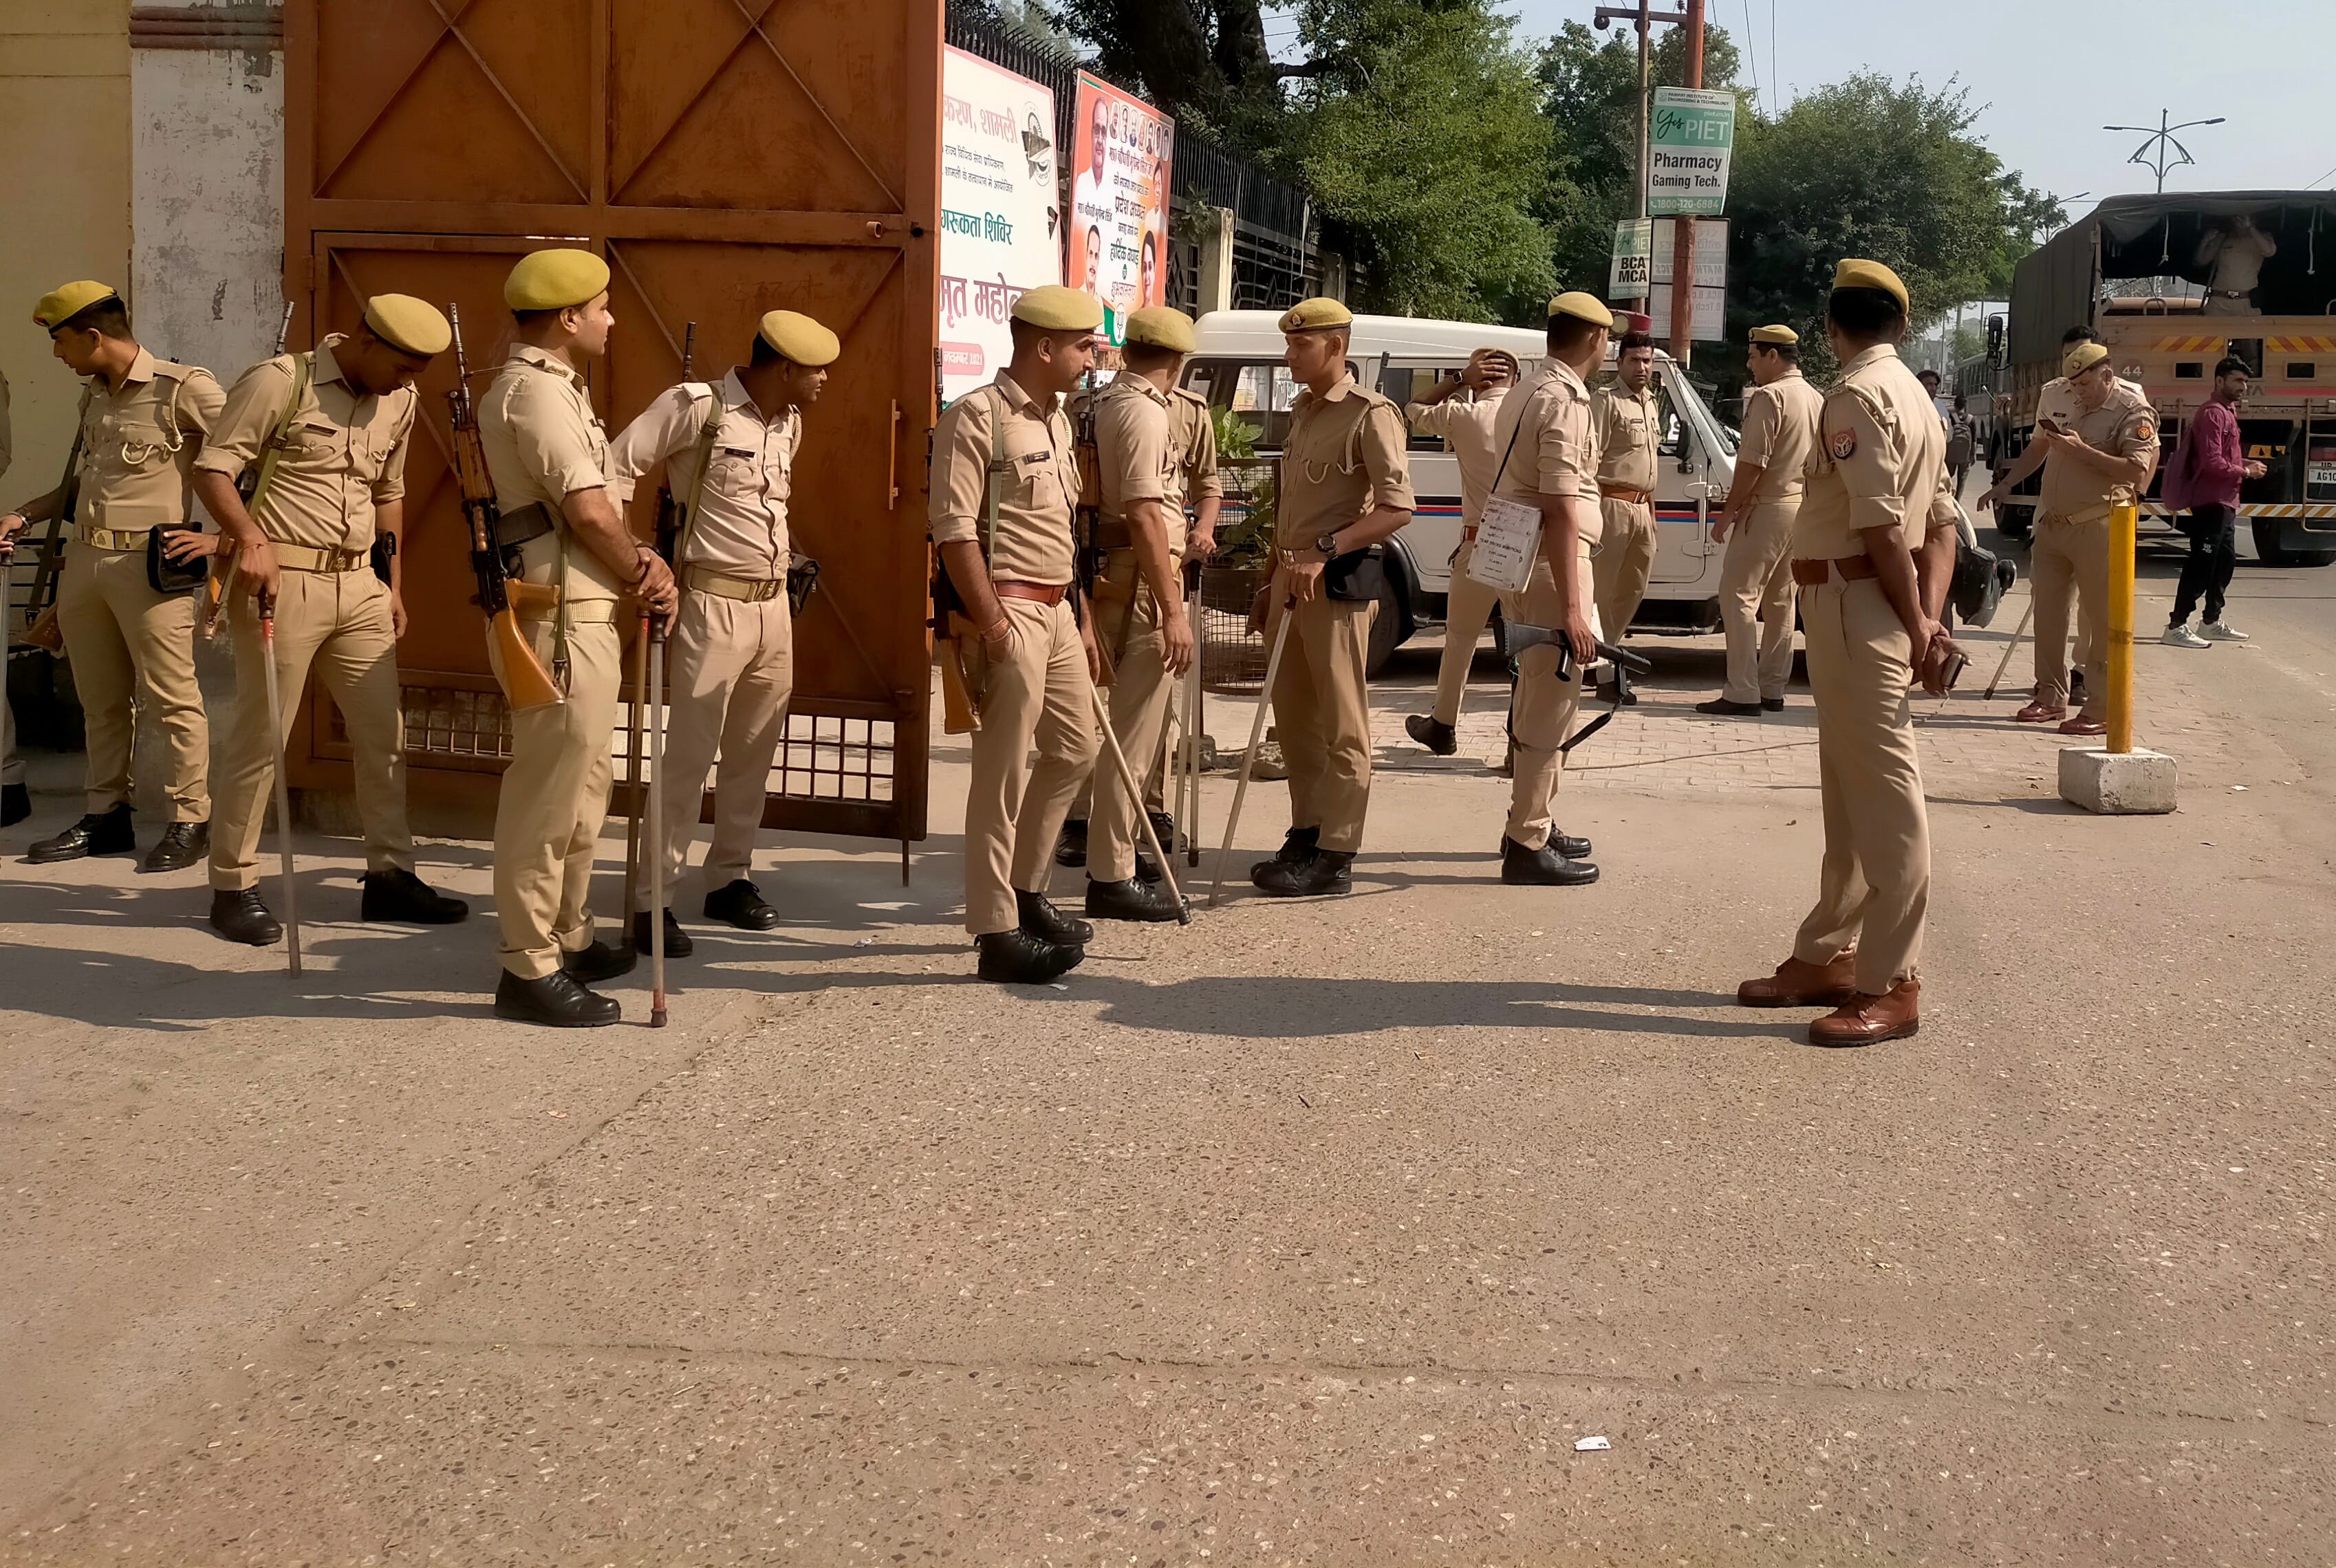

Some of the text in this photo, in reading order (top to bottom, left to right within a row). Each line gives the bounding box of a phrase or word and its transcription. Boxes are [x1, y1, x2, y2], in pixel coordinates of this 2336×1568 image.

[980, 107, 1018, 144] शामली
[1656, 109, 1729, 141] Yes PIET
[1654, 153, 1722, 172] Pharmacy
[1652, 174, 1720, 189] Gaming Tech.
[1115, 190, 1129, 215] प्रदेश
[1657, 199, 1719, 208] 1800-120-6884
[984, 211, 1013, 246] शिविर
[1110, 237, 1127, 261] हार्दिक
[1632, 237, 1651, 250] PIET
[1621, 256, 1646, 270] BCA
[1618, 270, 1647, 283] MCA
[2122, 365, 2142, 376] 44
[2322, 461, 2333, 470] UP
